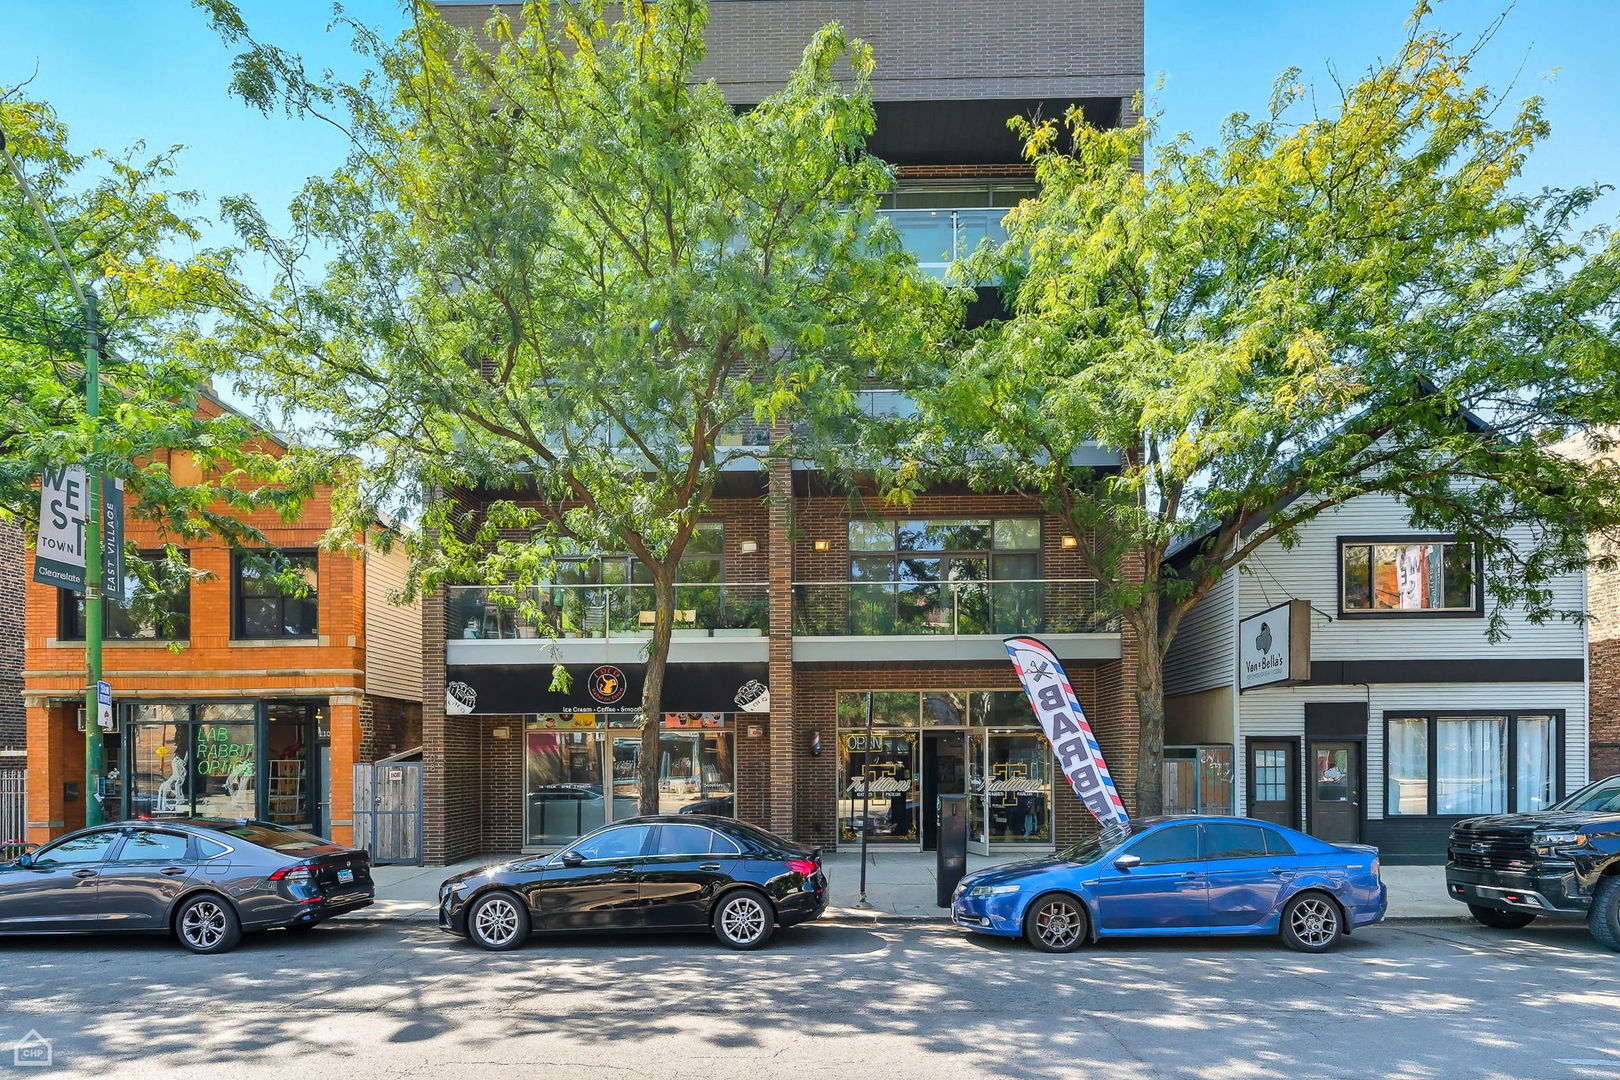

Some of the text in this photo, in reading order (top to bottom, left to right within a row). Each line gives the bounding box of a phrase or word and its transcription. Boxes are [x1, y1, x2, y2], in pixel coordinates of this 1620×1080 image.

[43, 462, 85, 557] WEST
[41, 536, 75, 555] TOWN
[38, 566, 81, 583] Cleanslate
[107, 562, 116, 592] EAST
[1246, 660, 1258, 673] Van
[1262, 653, 1283, 670] Bella's
[197, 727, 229, 742] LAB
[196, 743, 254, 759] RABBIT
